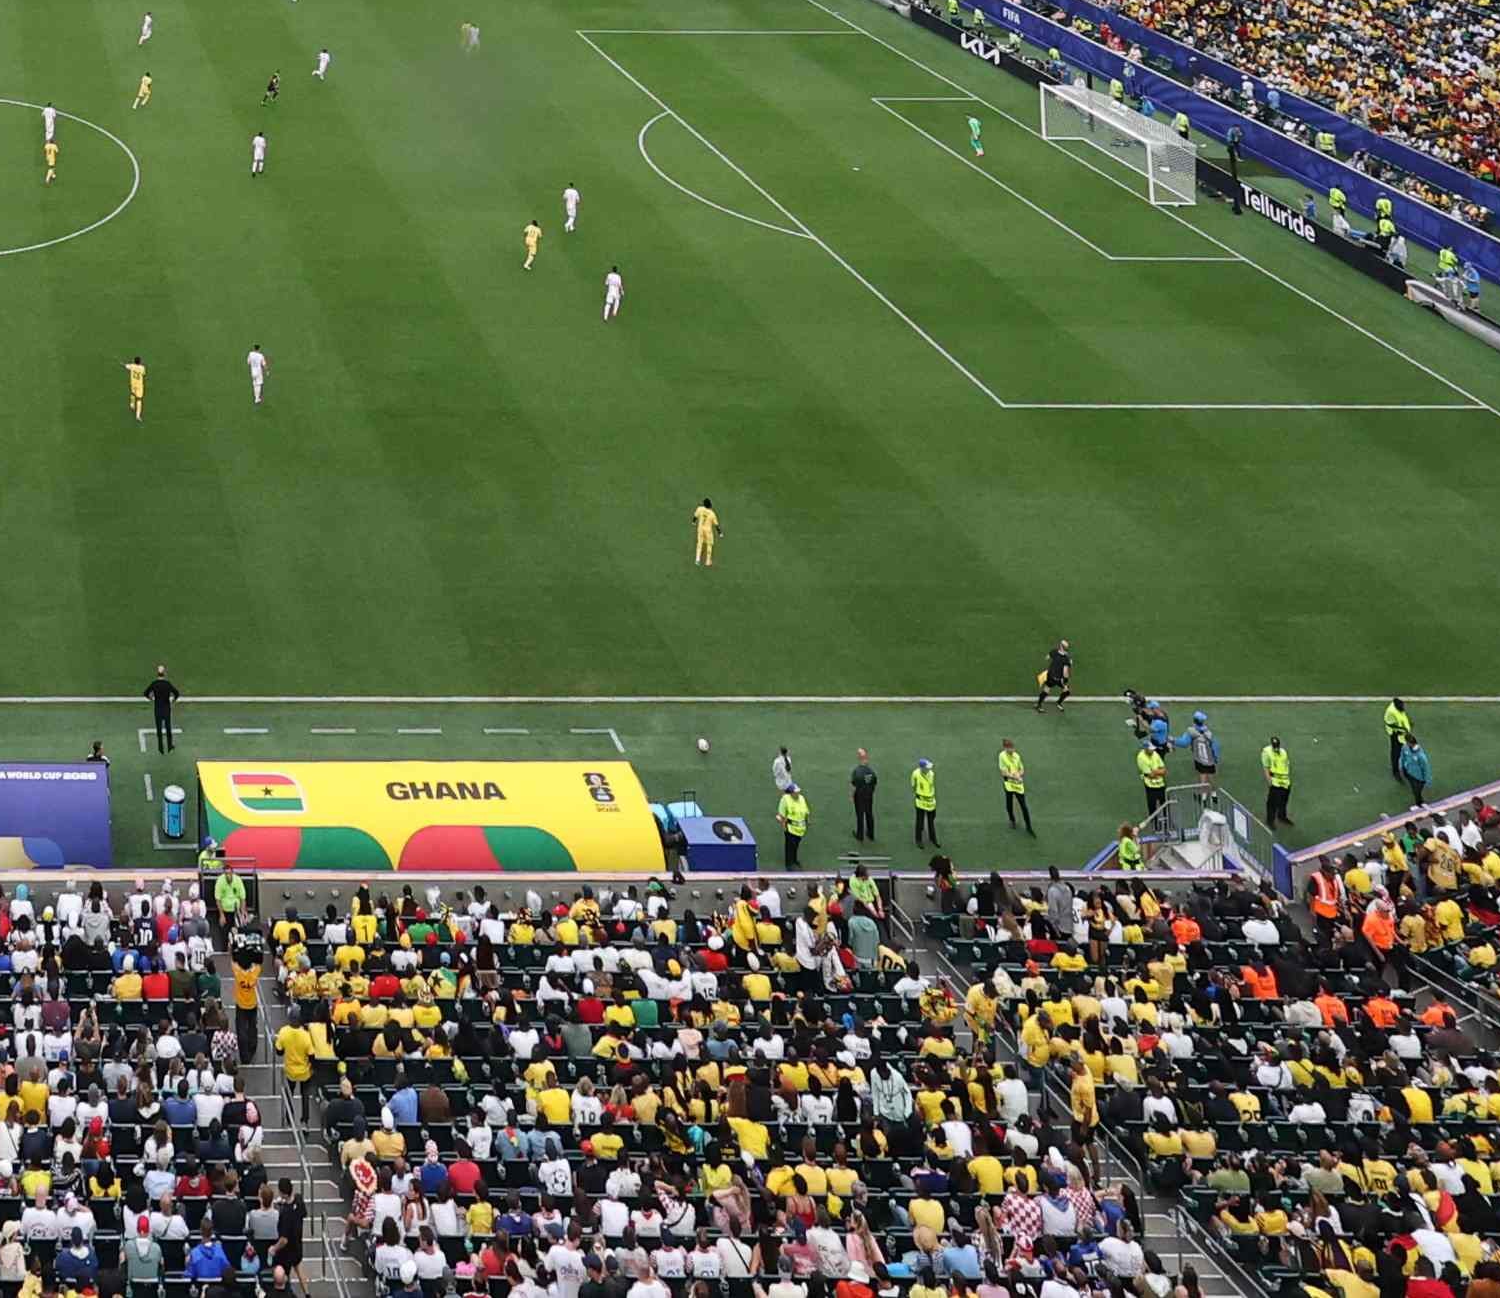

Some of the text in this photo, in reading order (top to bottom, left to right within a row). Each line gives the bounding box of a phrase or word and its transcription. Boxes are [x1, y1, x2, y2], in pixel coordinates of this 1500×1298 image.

[1002, 6, 1021, 25] FIFA
[1240, 183, 1316, 244] Telluride
[6, 770, 42, 781] WORLD
[42, 771, 62, 781] CUP
[62, 771, 97, 781] 2026
[384, 780, 507, 802] GHANA
[138, 928, 153, 946] 10
